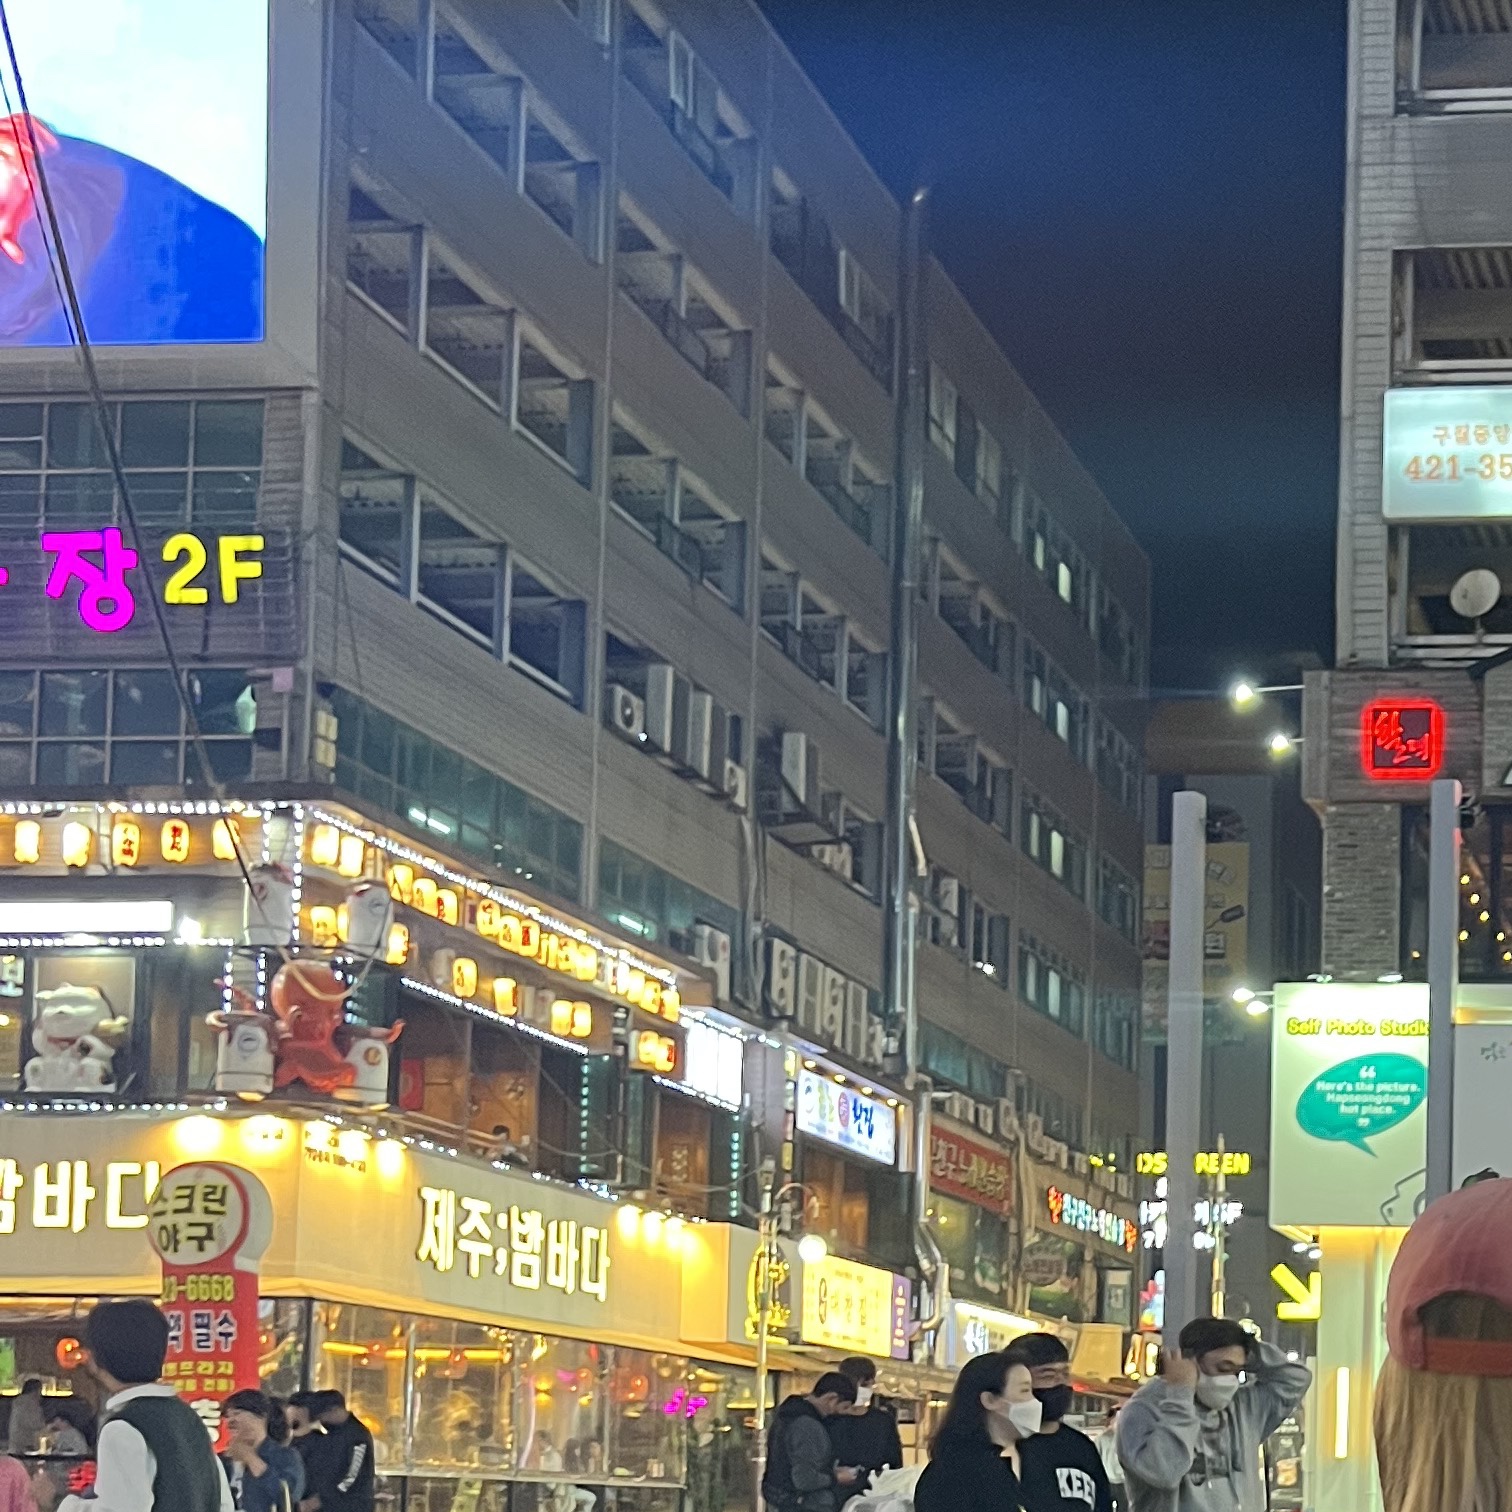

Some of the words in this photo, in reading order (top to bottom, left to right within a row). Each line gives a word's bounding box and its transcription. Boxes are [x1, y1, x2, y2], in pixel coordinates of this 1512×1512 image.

[0, 526, 138, 633] 장
[162, 533, 264, 604] 2F
[1287, 1017, 1321, 1035] Self
[1326, 1019, 1376, 1035] Photo
[1380, 1019, 1429, 1036] Studi
[152, 1185, 228, 1217] 스크린
[158, 1222, 216, 1253] 야구
[191, 1309, 237, 1353] 필수
[1056, 1467, 1096, 1511] KEE
